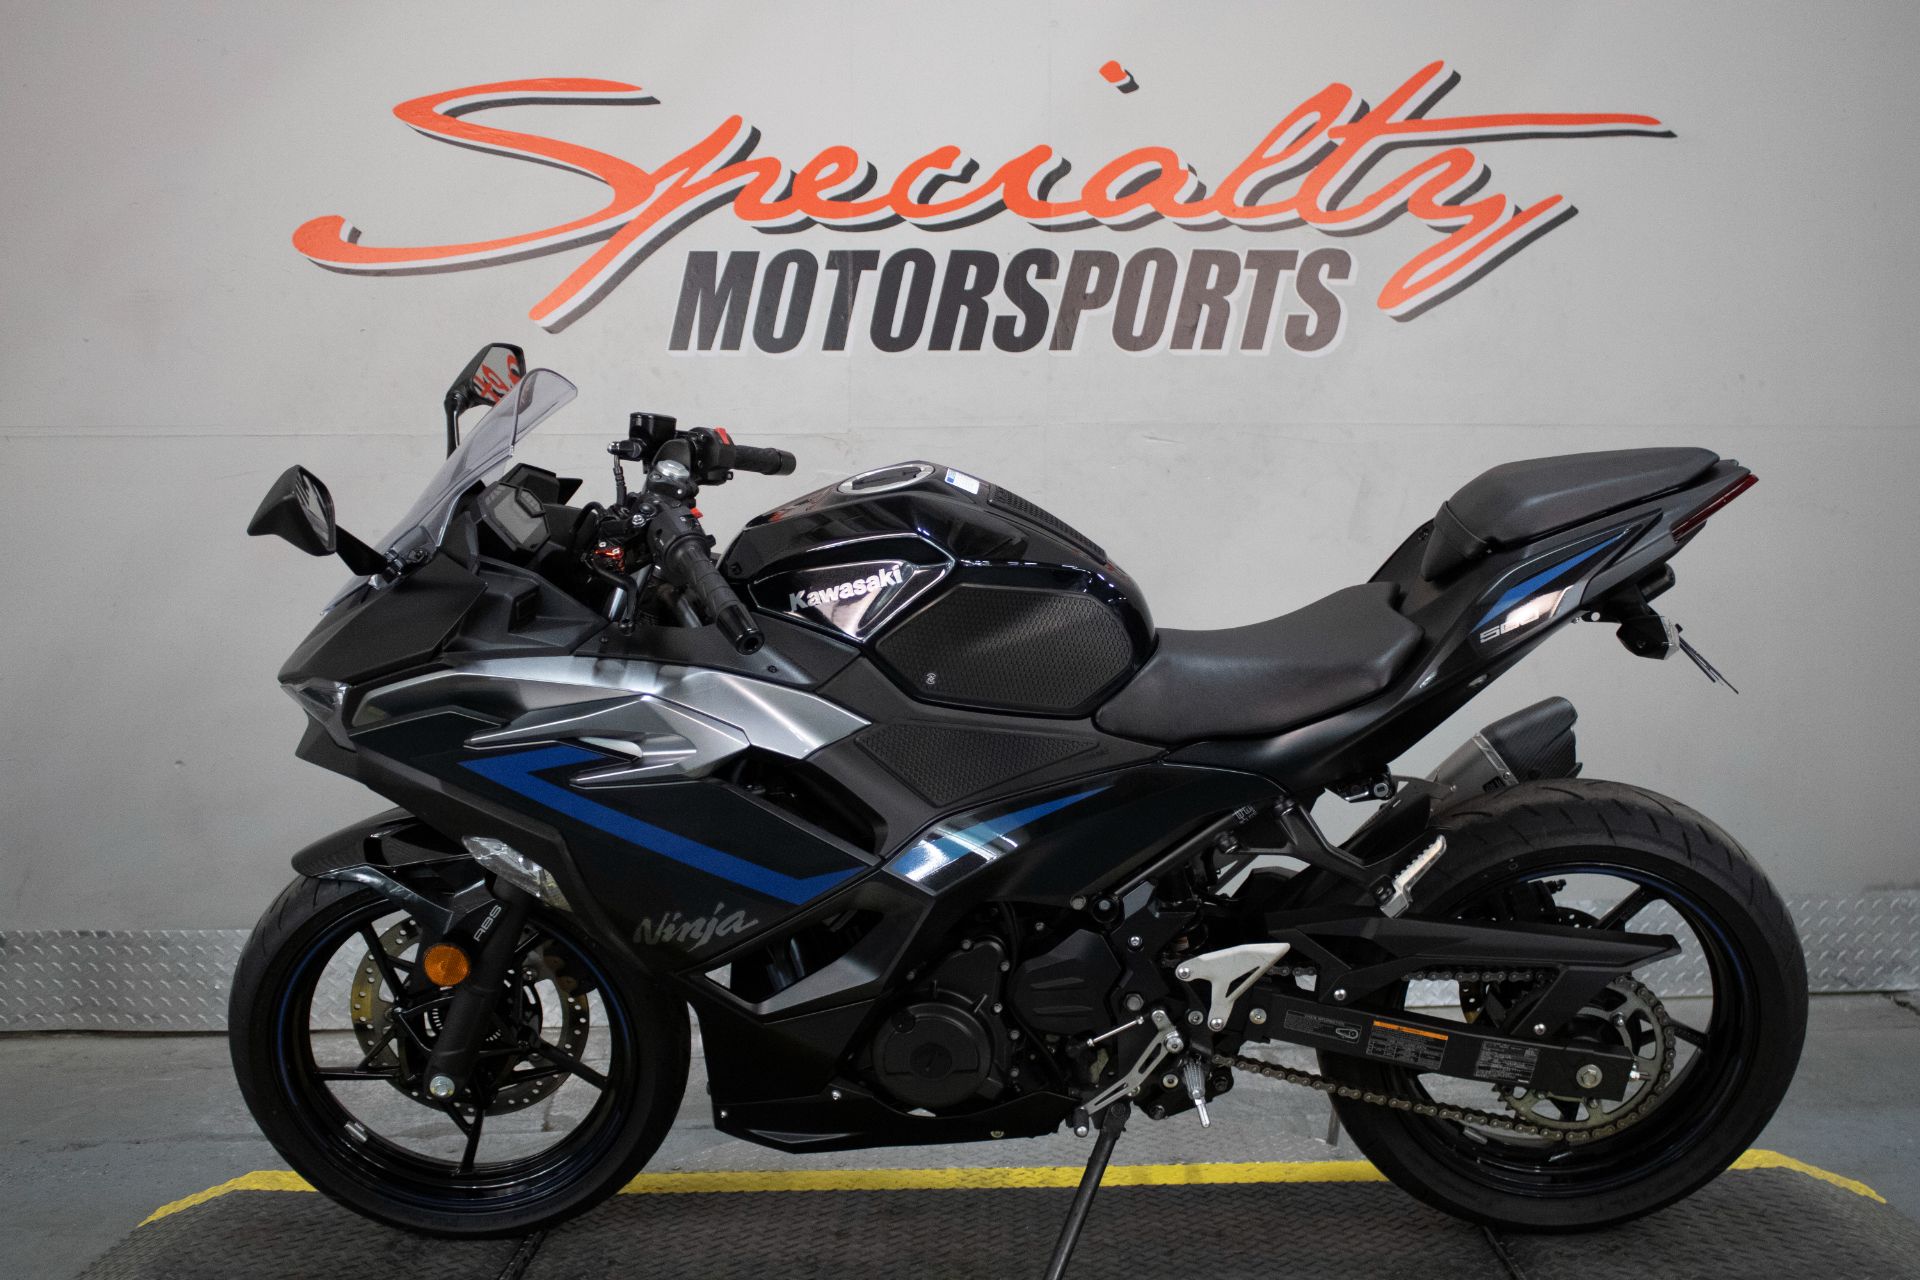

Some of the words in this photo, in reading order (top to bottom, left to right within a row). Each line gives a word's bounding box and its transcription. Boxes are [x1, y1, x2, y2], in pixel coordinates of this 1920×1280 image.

[292, 60, 1677, 333] Specialty
[668, 246, 1354, 354] MOTORSPORTS
[789, 564, 904, 612] Kawasaki
[473, 904, 502, 942] ABS
[632, 901, 760, 953] Ninja
